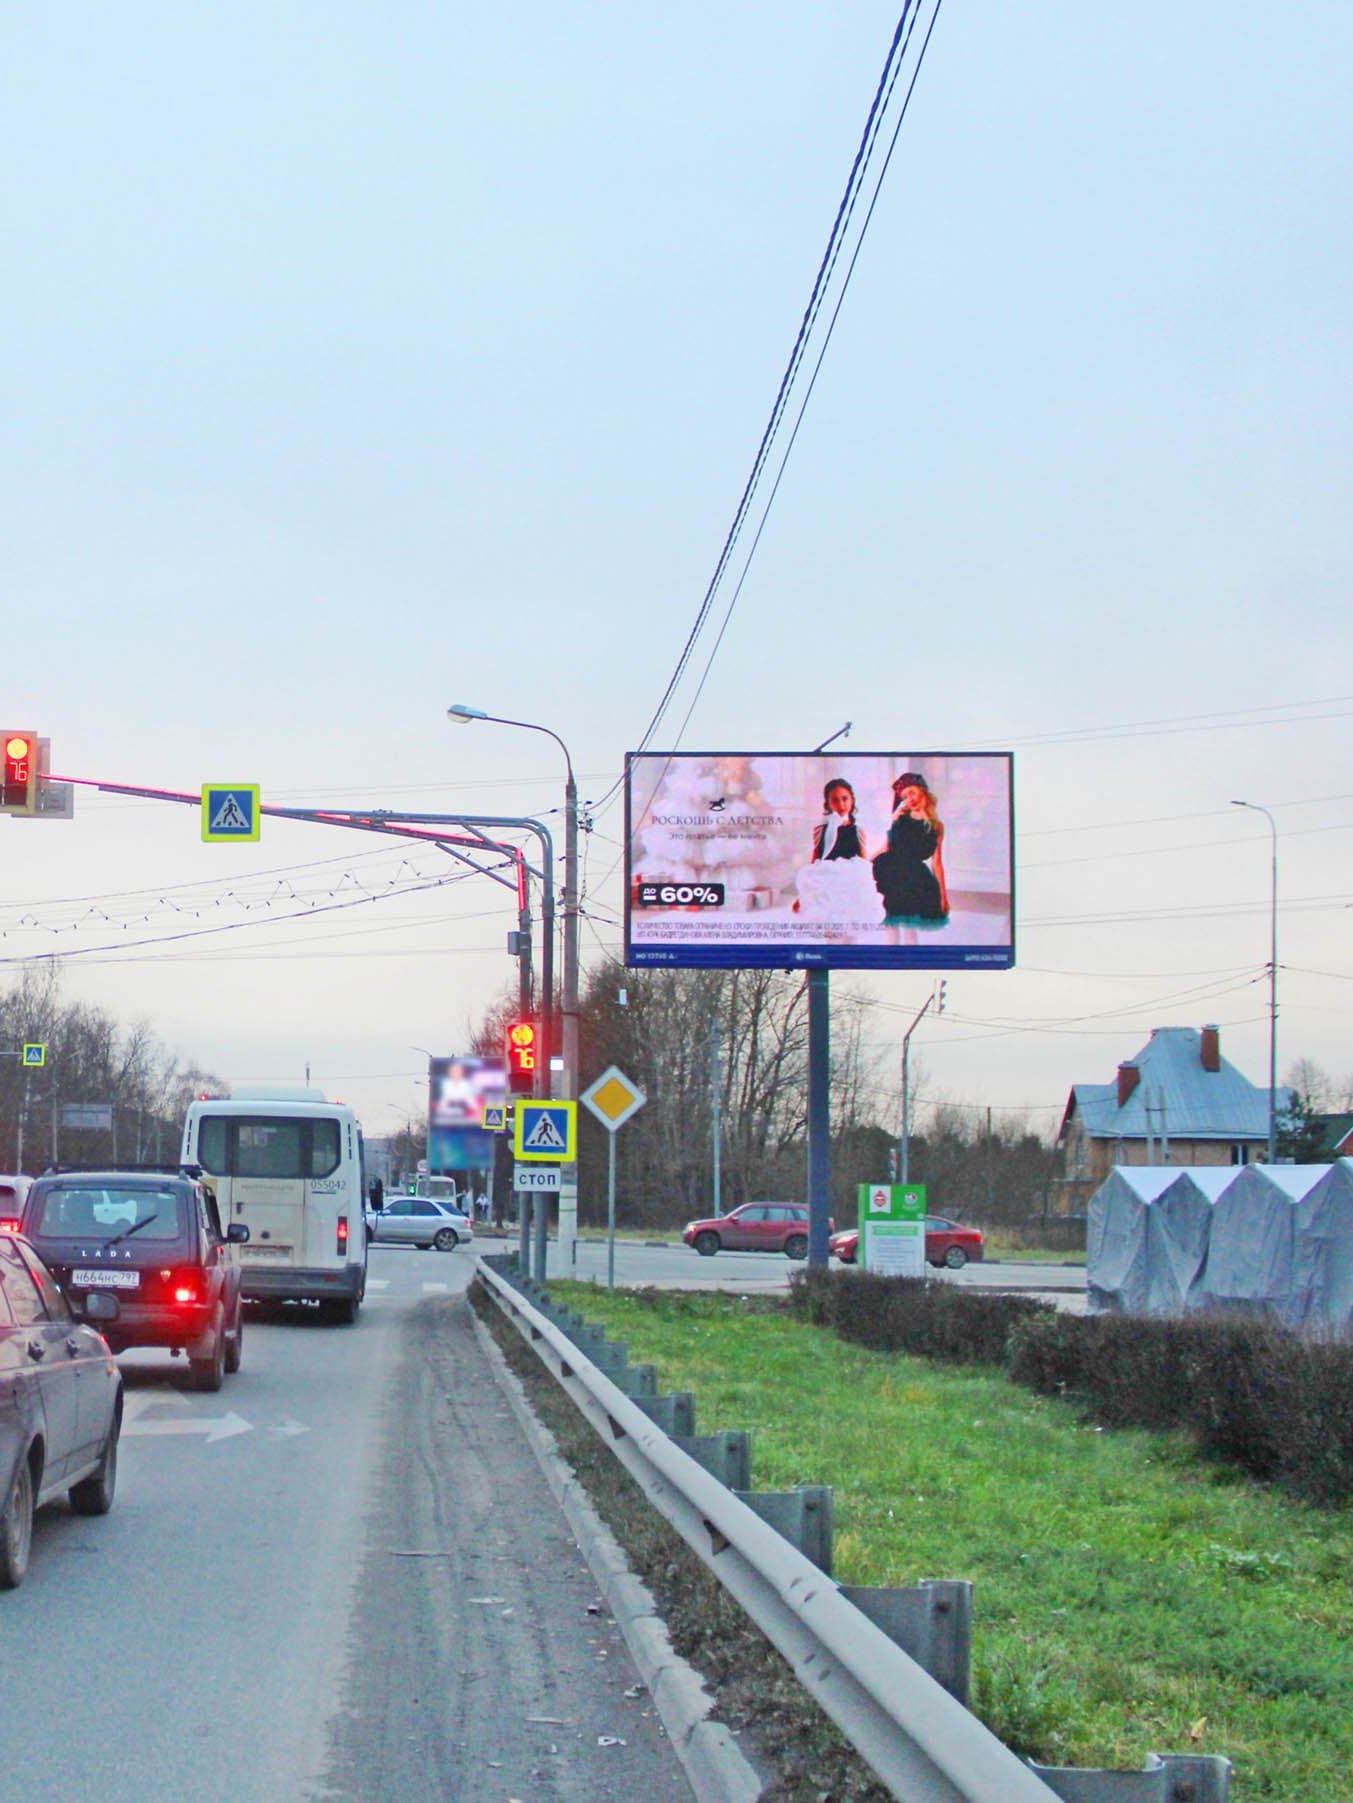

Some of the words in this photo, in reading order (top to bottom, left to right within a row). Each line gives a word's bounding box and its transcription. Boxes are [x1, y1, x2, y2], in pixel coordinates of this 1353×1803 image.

[9, 762, 27, 781] 76
[651, 815, 713, 825] РОСКОШЬ
[728, 815, 784, 826] ДЕТСТВА
[660, 886, 719, 903] 60%
[519, 1174, 556, 1185] СТОП
[81, 1249, 131, 1258] LADA
